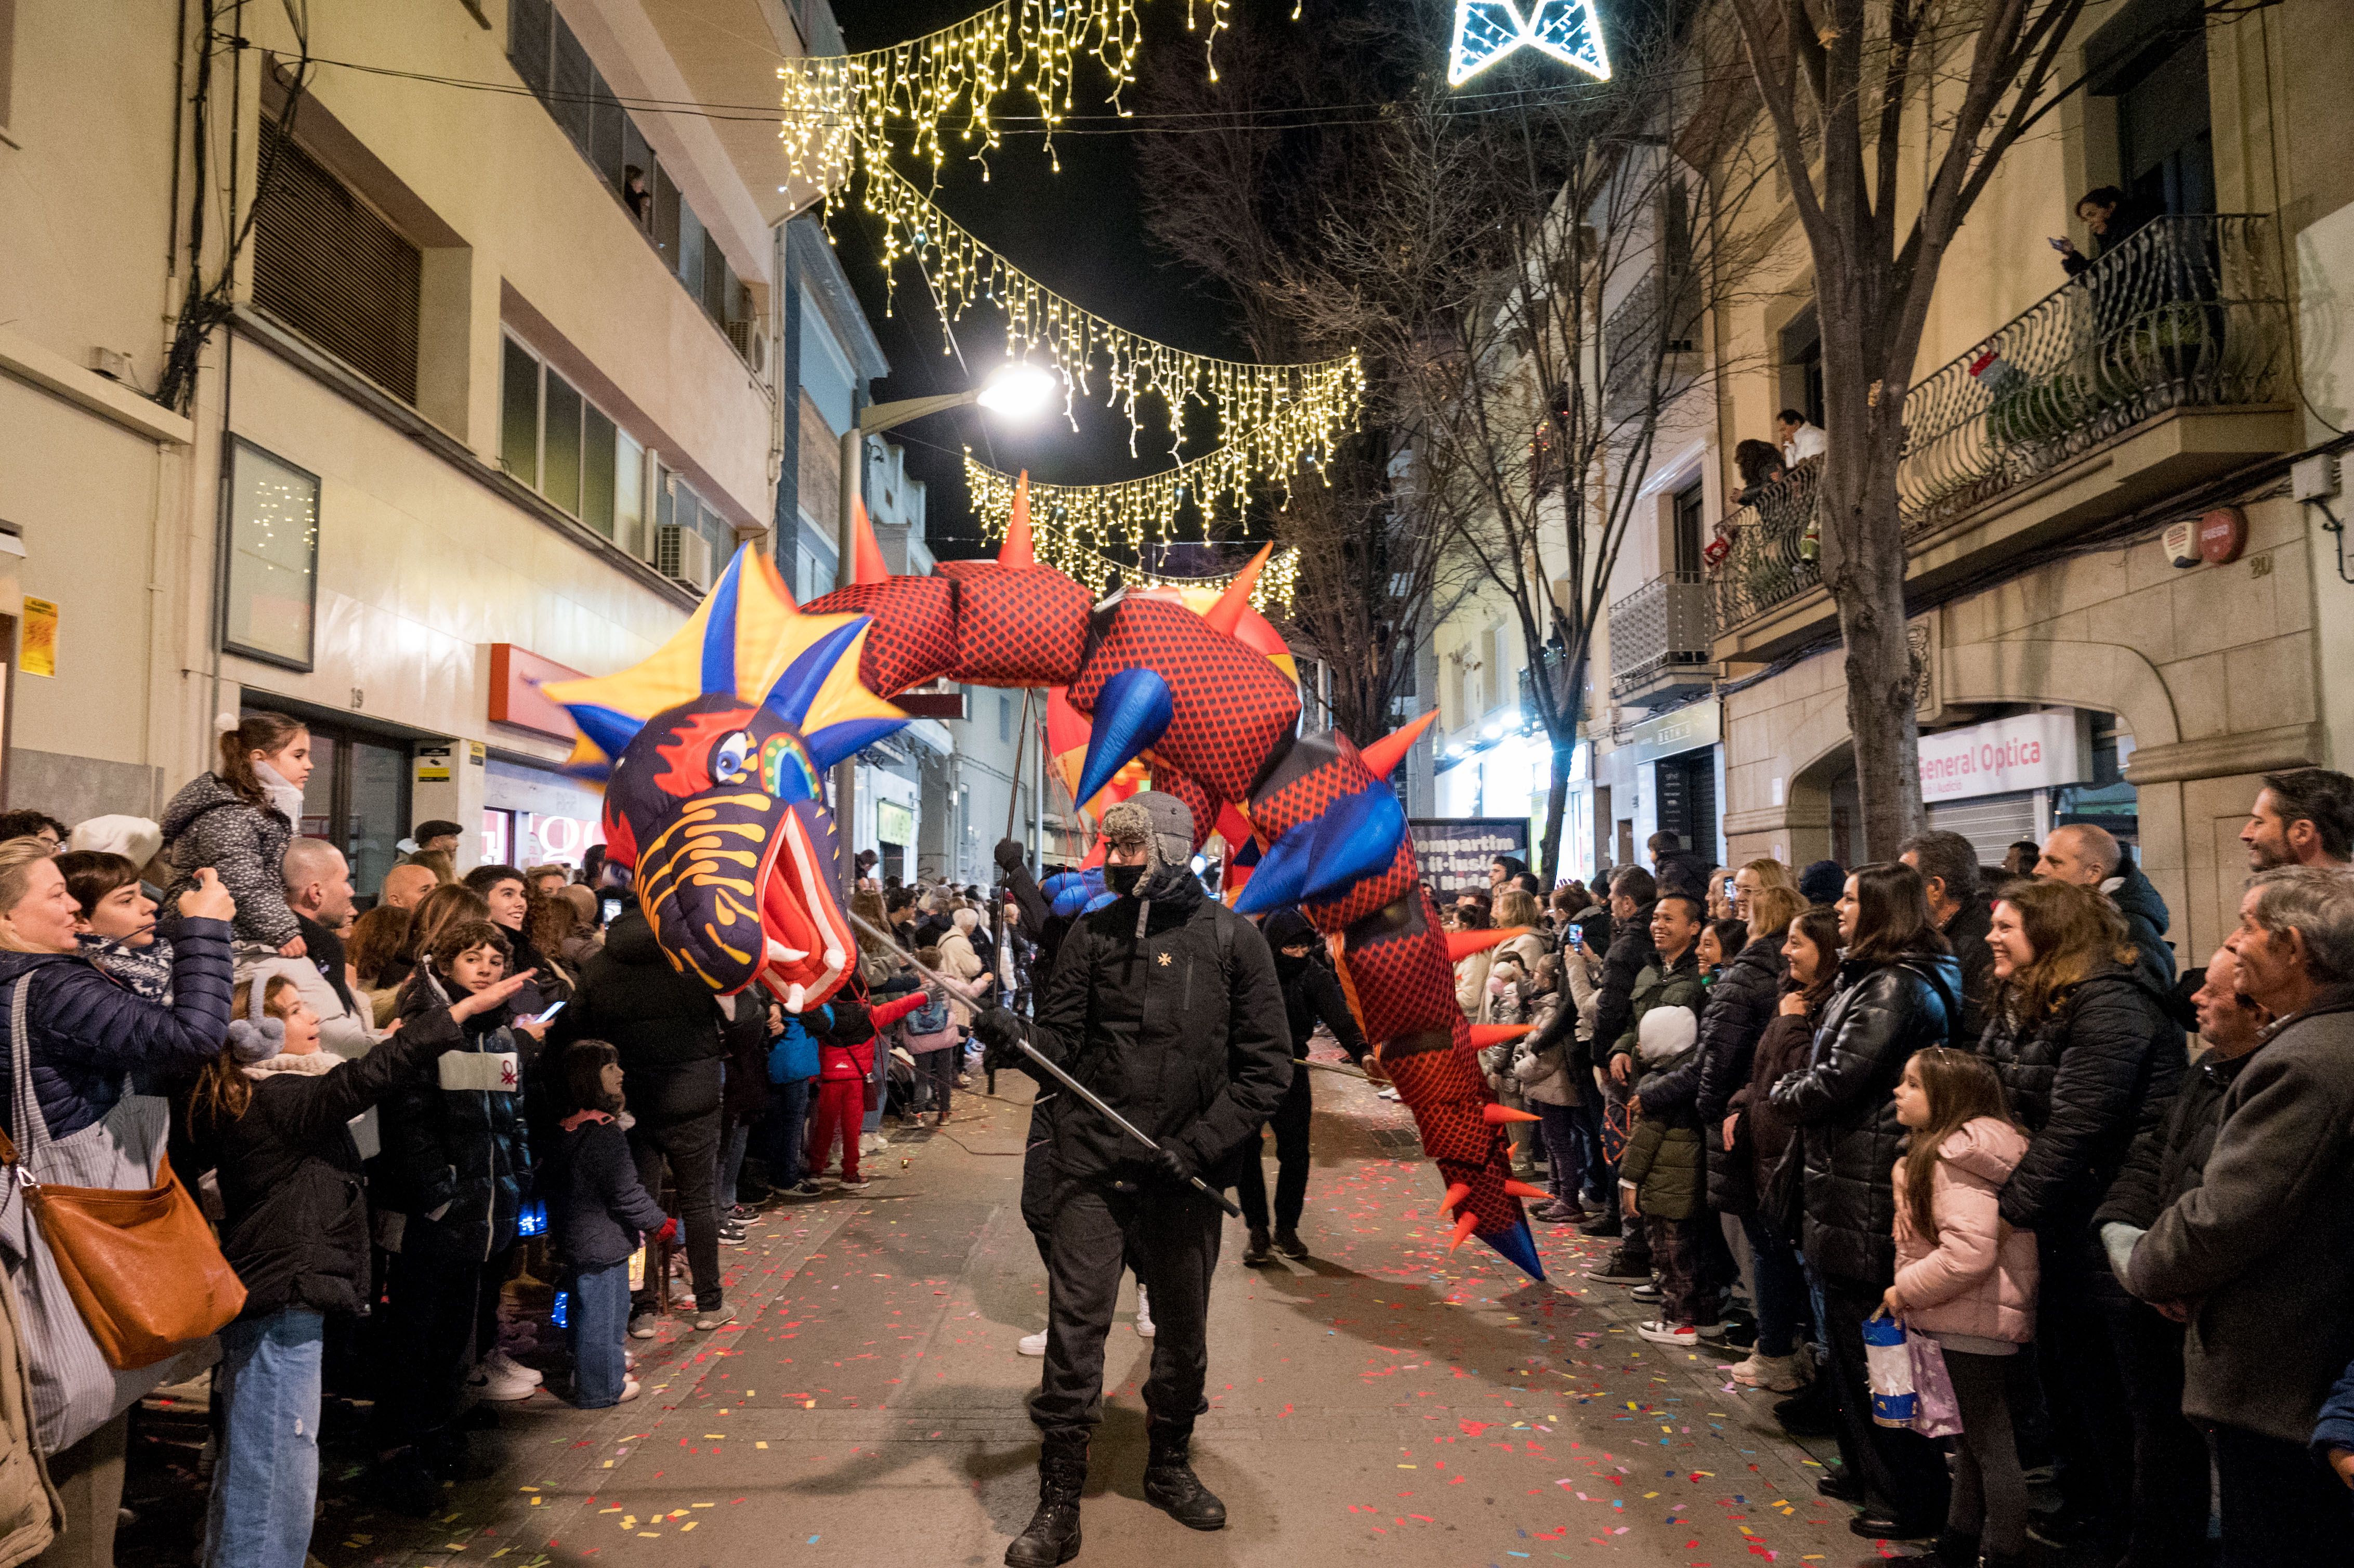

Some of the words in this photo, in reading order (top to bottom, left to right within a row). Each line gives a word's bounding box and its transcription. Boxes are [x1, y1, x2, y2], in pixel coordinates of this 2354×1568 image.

[350, 687, 363, 708] 19
[1981, 737, 2041, 776] Optica
[1441, 873, 1492, 891] Nada
